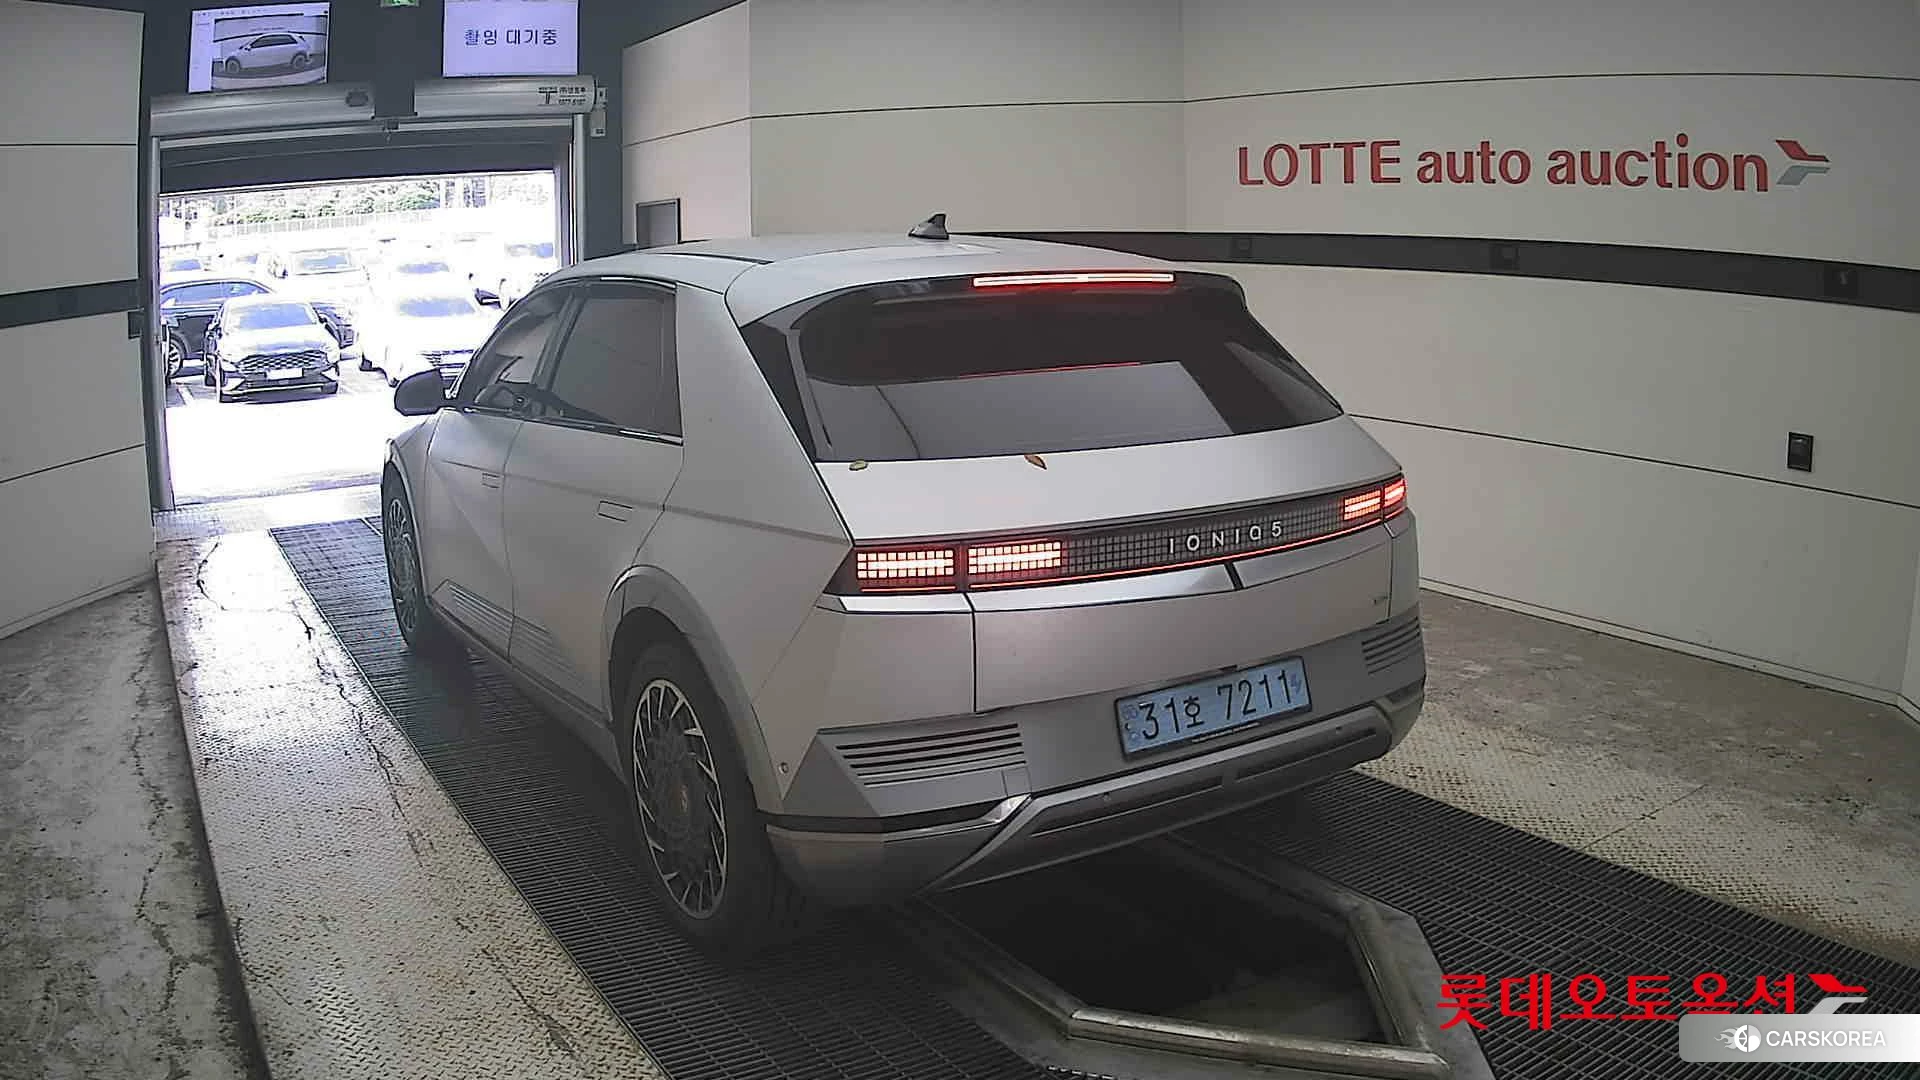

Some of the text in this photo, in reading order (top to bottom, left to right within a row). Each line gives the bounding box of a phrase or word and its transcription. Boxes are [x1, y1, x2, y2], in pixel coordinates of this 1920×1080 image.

[506, 29, 558, 46] 대기중
[1238, 132, 1769, 193] LOTTE auto auction
[1138, 669, 1292, 740] 31호 7211
